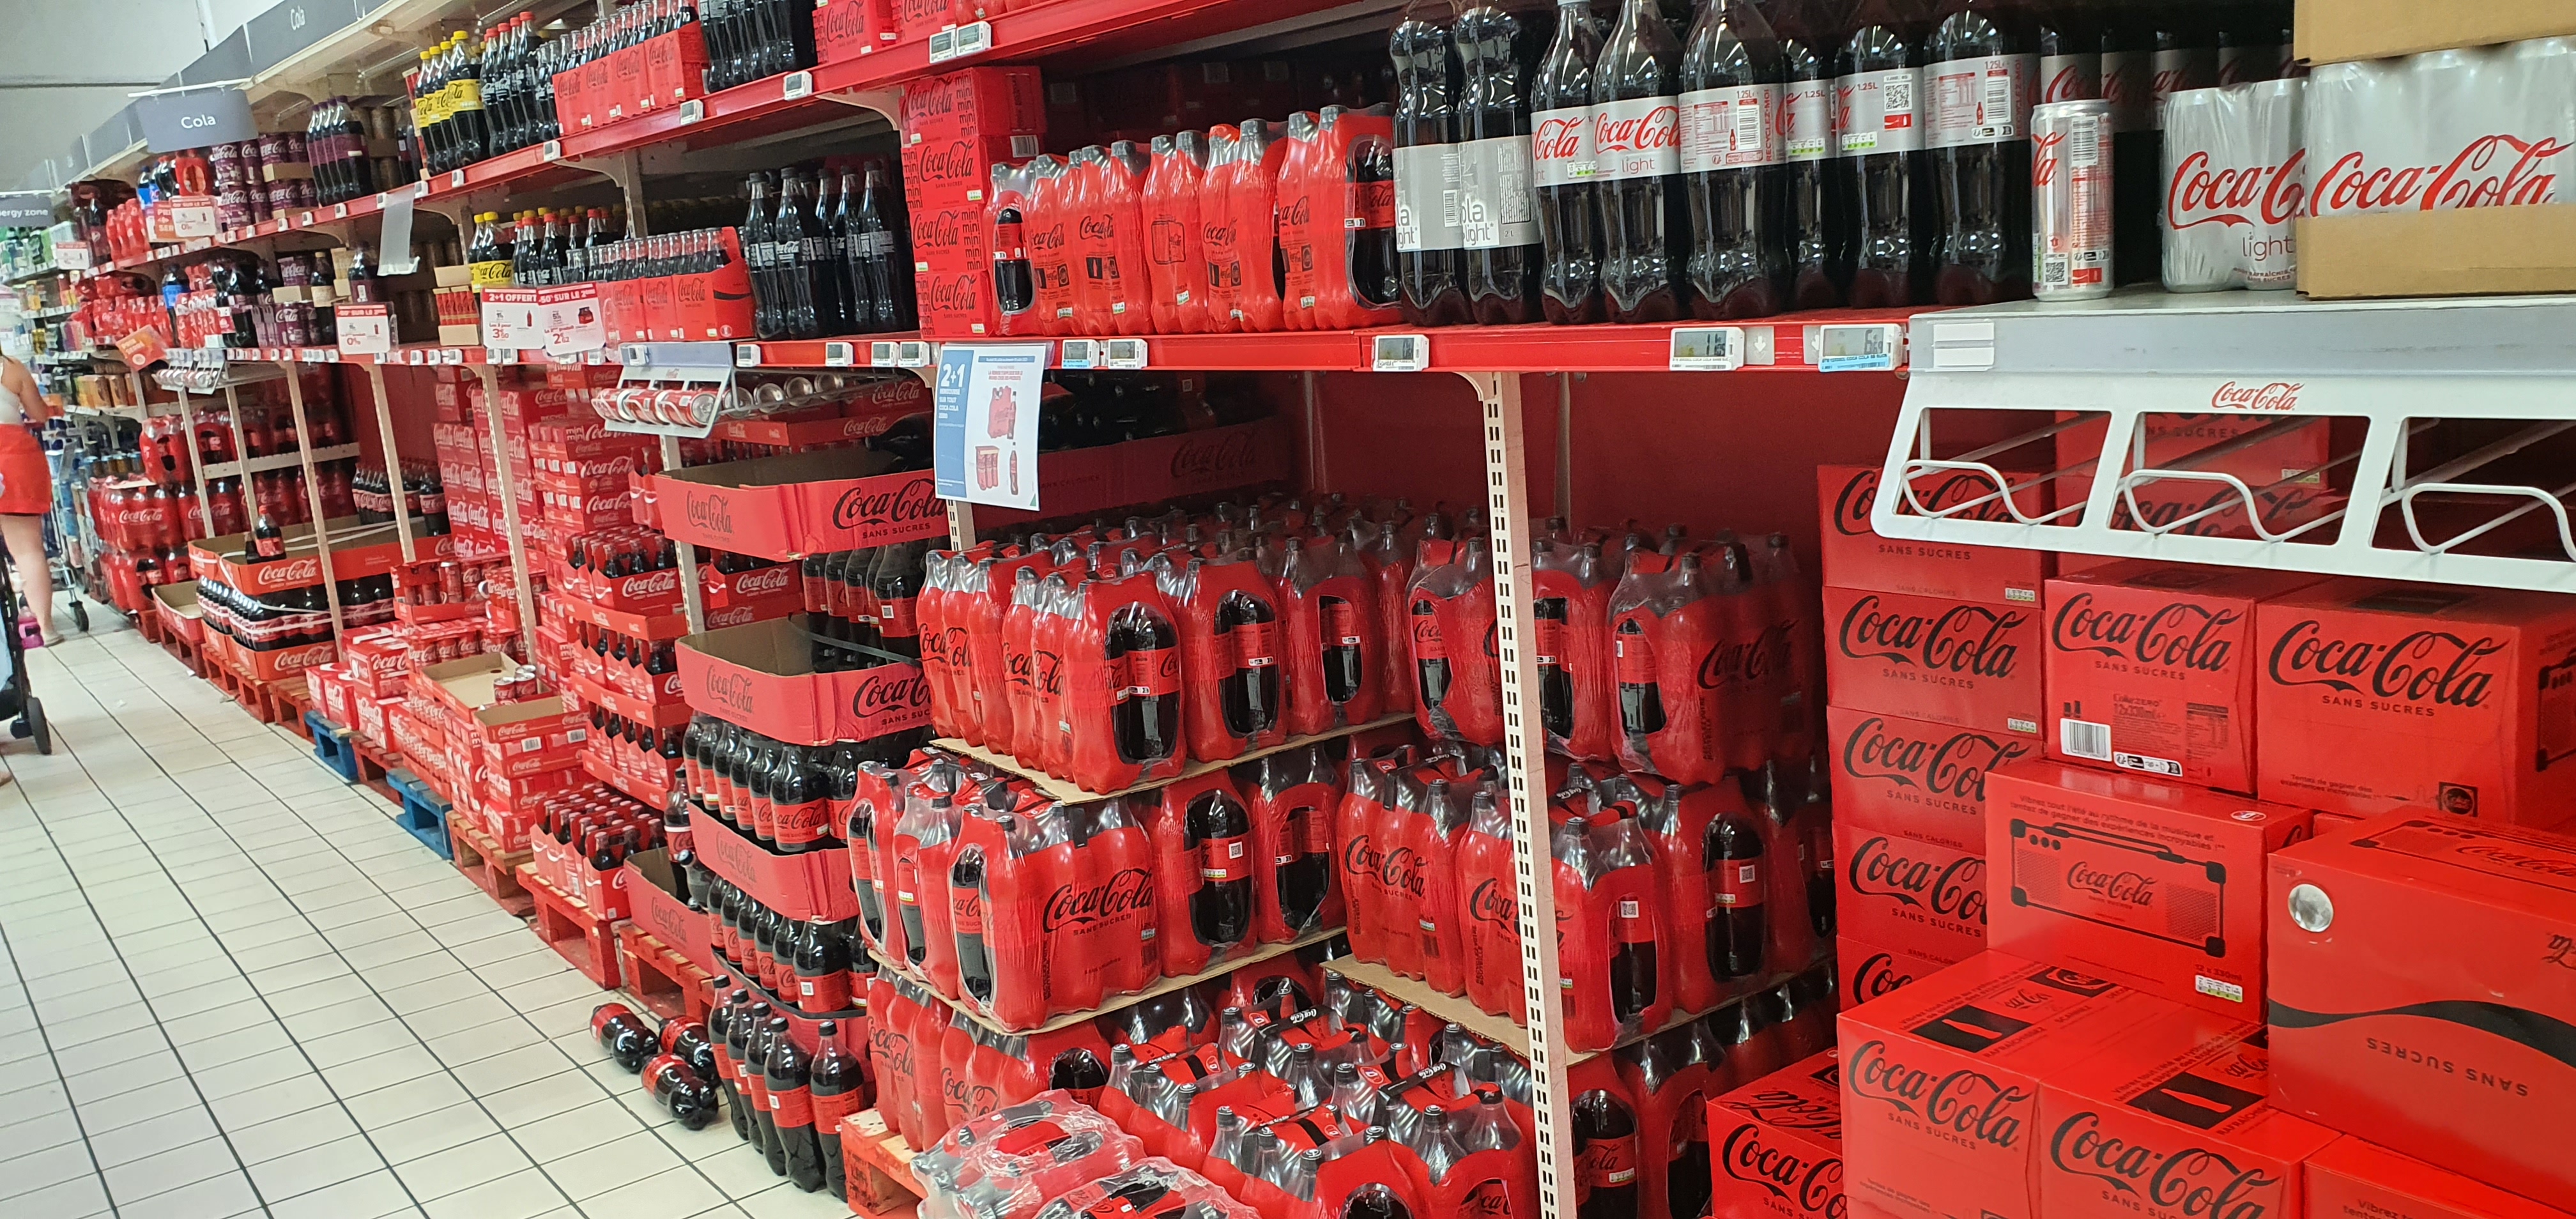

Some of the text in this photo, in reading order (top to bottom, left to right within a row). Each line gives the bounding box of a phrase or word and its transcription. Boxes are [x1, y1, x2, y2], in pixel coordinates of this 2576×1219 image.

[291, 5, 305, 31] Cola
[955, 71, 971, 86] mini
[1857, 82, 1878, 91] 1.25L
[908, 75, 953, 119] Coca-Cola
[956, 83, 972, 99] mini
[1804, 89, 1825, 98] 1.25L
[958, 95, 974, 111] mini
[181, 114, 216, 129] Cola
[960, 109, 975, 123] mini
[961, 121, 977, 137] mini
[902, 148, 917, 160] mini
[920, 139, 976, 182] Coca-Cola
[1621, 156, 1655, 174] light
[904, 161, 918, 173] mini
[905, 172, 920, 185] mini
[2310, 134, 2573, 217] Coca-Cola
[907, 185, 921, 197] mini
[908, 198, 923, 208] mini
[962, 208, 978, 221] mini
[913, 210, 960, 249] Coca-Cola
[963, 220, 979, 234] mini
[964, 233, 981, 246] mini
[2242, 231, 2295, 261] light
[965, 245, 982, 258] mini
[967, 258, 983, 270] mini
[554, 293, 570, 302] SUR
[931, 275, 977, 310] Coca-Cola
[941, 364, 965, 387] 2+1
[872, 381, 921, 404] Coca-Cola
[2212, 381, 2304, 411] Coca-Cola
[844, 417, 887, 436] Coca-Cola
[687, 490, 734, 533] Coca-Cola
[832, 479, 947, 530] Coca-Cola
[119, 509, 162, 524] Coca-Cola
[862, 522, 930, 539] SANS SUCRES
[1878, 544, 1972, 561] SANS SUCRES
[258, 558, 317, 585] Coca-Cola
[736, 567, 789, 594] Coca-Cola
[622, 571, 676, 597] Coca-Cola
[707, 606, 754, 628] Coca-Cola
[1839, 595, 2030, 678] Coca-Cola
[2053, 592, 2242, 673] Coca-Cola
[274, 644, 334, 671] Coca-Cola
[2269, 620, 2510, 707] Coca-Cola
[1883, 668, 1974, 690] SANS SUCRES
[2095, 661, 2186, 681] SANS SUCRES
[707, 664, 755, 714] Coca-Cola
[2322, 694, 2435, 717] SANS SUCRES
[882, 714, 908, 724] SANS
[1843, 717, 2030, 803] Coca-Col
[1887, 790, 1977, 816] SANS SUCRES
[716, 831, 756, 880] Coca-Cola
[1346, 834, 1429, 898] Coca-Cola
[2067, 861, 2158, 906] Coca-Cola
[1043, 868, 1153, 933] Coca-Cola
[652, 896, 687, 942] Coca-Cola
[1073, 913, 1131, 936] SANS SUCRES
[1892, 907, 1982, 938] SANS SUCRES
[2366, 1036, 2529, 1098] SANS SUCRES
[1848, 1040, 2030, 1148] Coca-Cola
[1888, 1113, 1977, 1150] SANS SUCRES
[1722, 1123, 1848, 1219] Coca-Co
[2051, 1112, 2281, 1219] Coca-Cola
[1763, 1197, 1793, 1218] SANS
[2102, 1190, 2140, 1211] SANS
